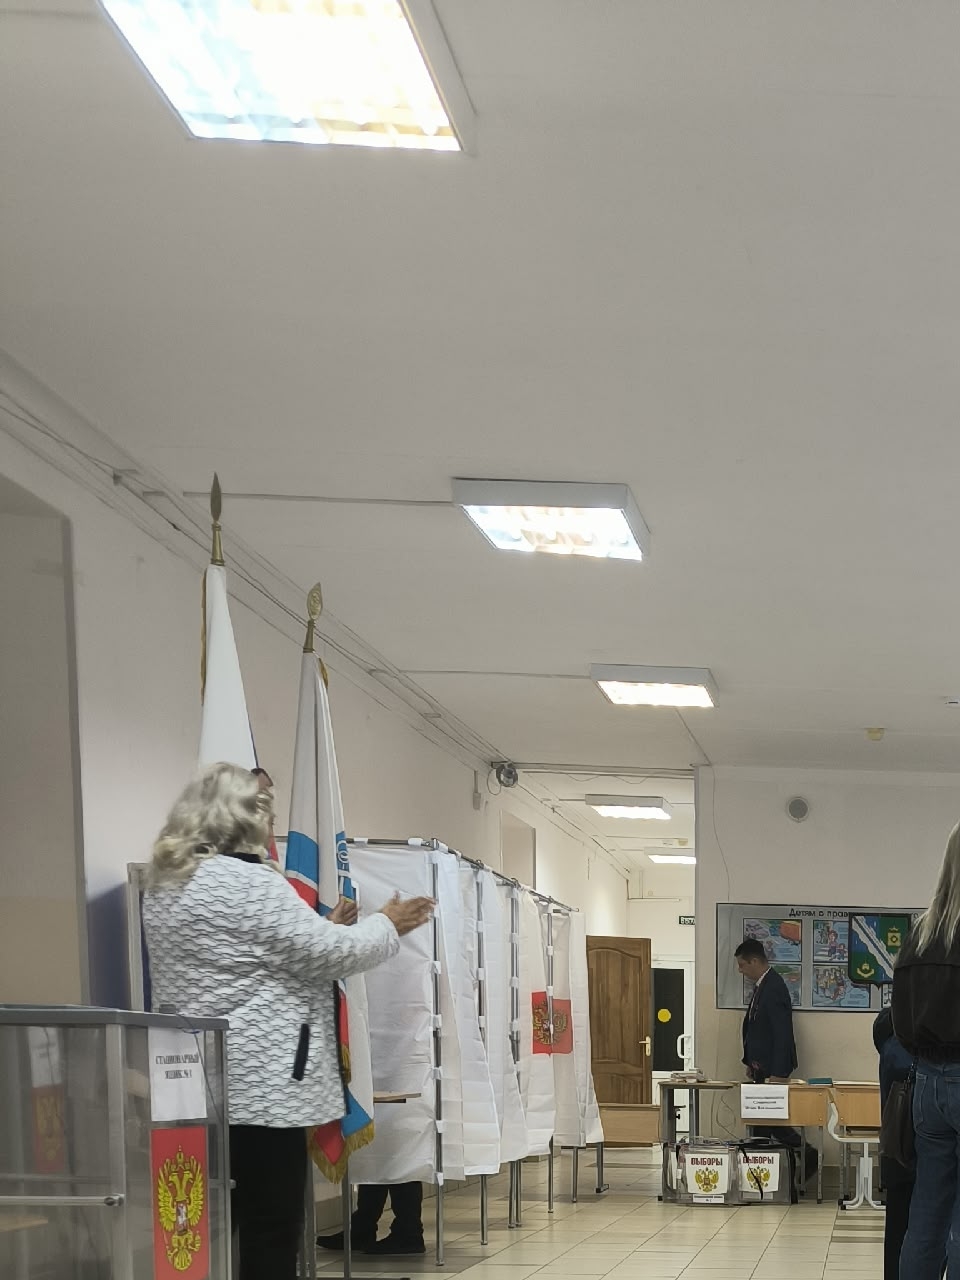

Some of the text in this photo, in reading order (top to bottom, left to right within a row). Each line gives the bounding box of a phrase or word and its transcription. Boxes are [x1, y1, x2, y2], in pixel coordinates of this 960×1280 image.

[788, 908, 816, 917] Детям
[826, 910, 849, 919] прав
[690, 1157, 723, 1166] ВЫБОРЫ
